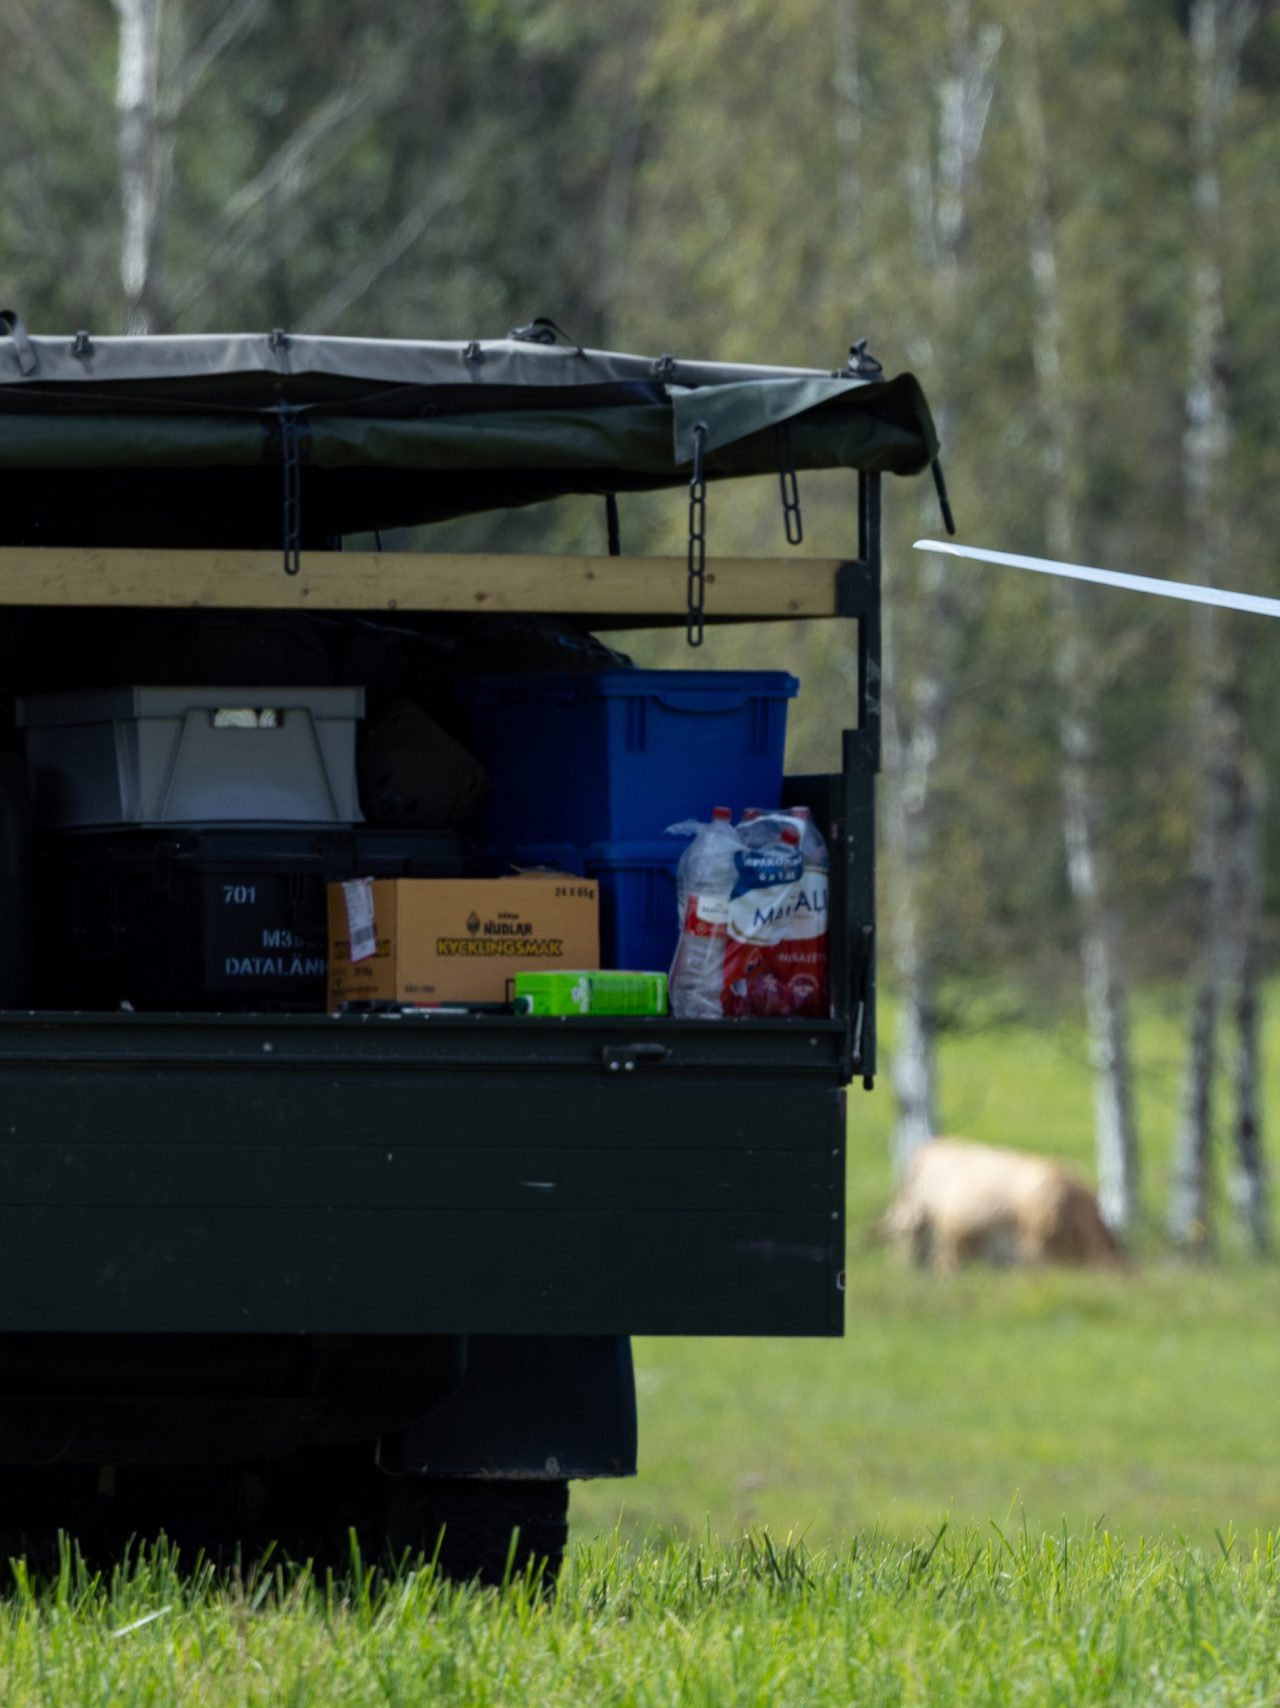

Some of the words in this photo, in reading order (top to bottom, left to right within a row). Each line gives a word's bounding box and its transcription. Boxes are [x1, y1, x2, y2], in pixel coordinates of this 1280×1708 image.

[223, 885, 256, 904] 701
[484, 920, 533, 936] NUDLAR
[436, 938, 563, 956] KYCKLINGSMAK
